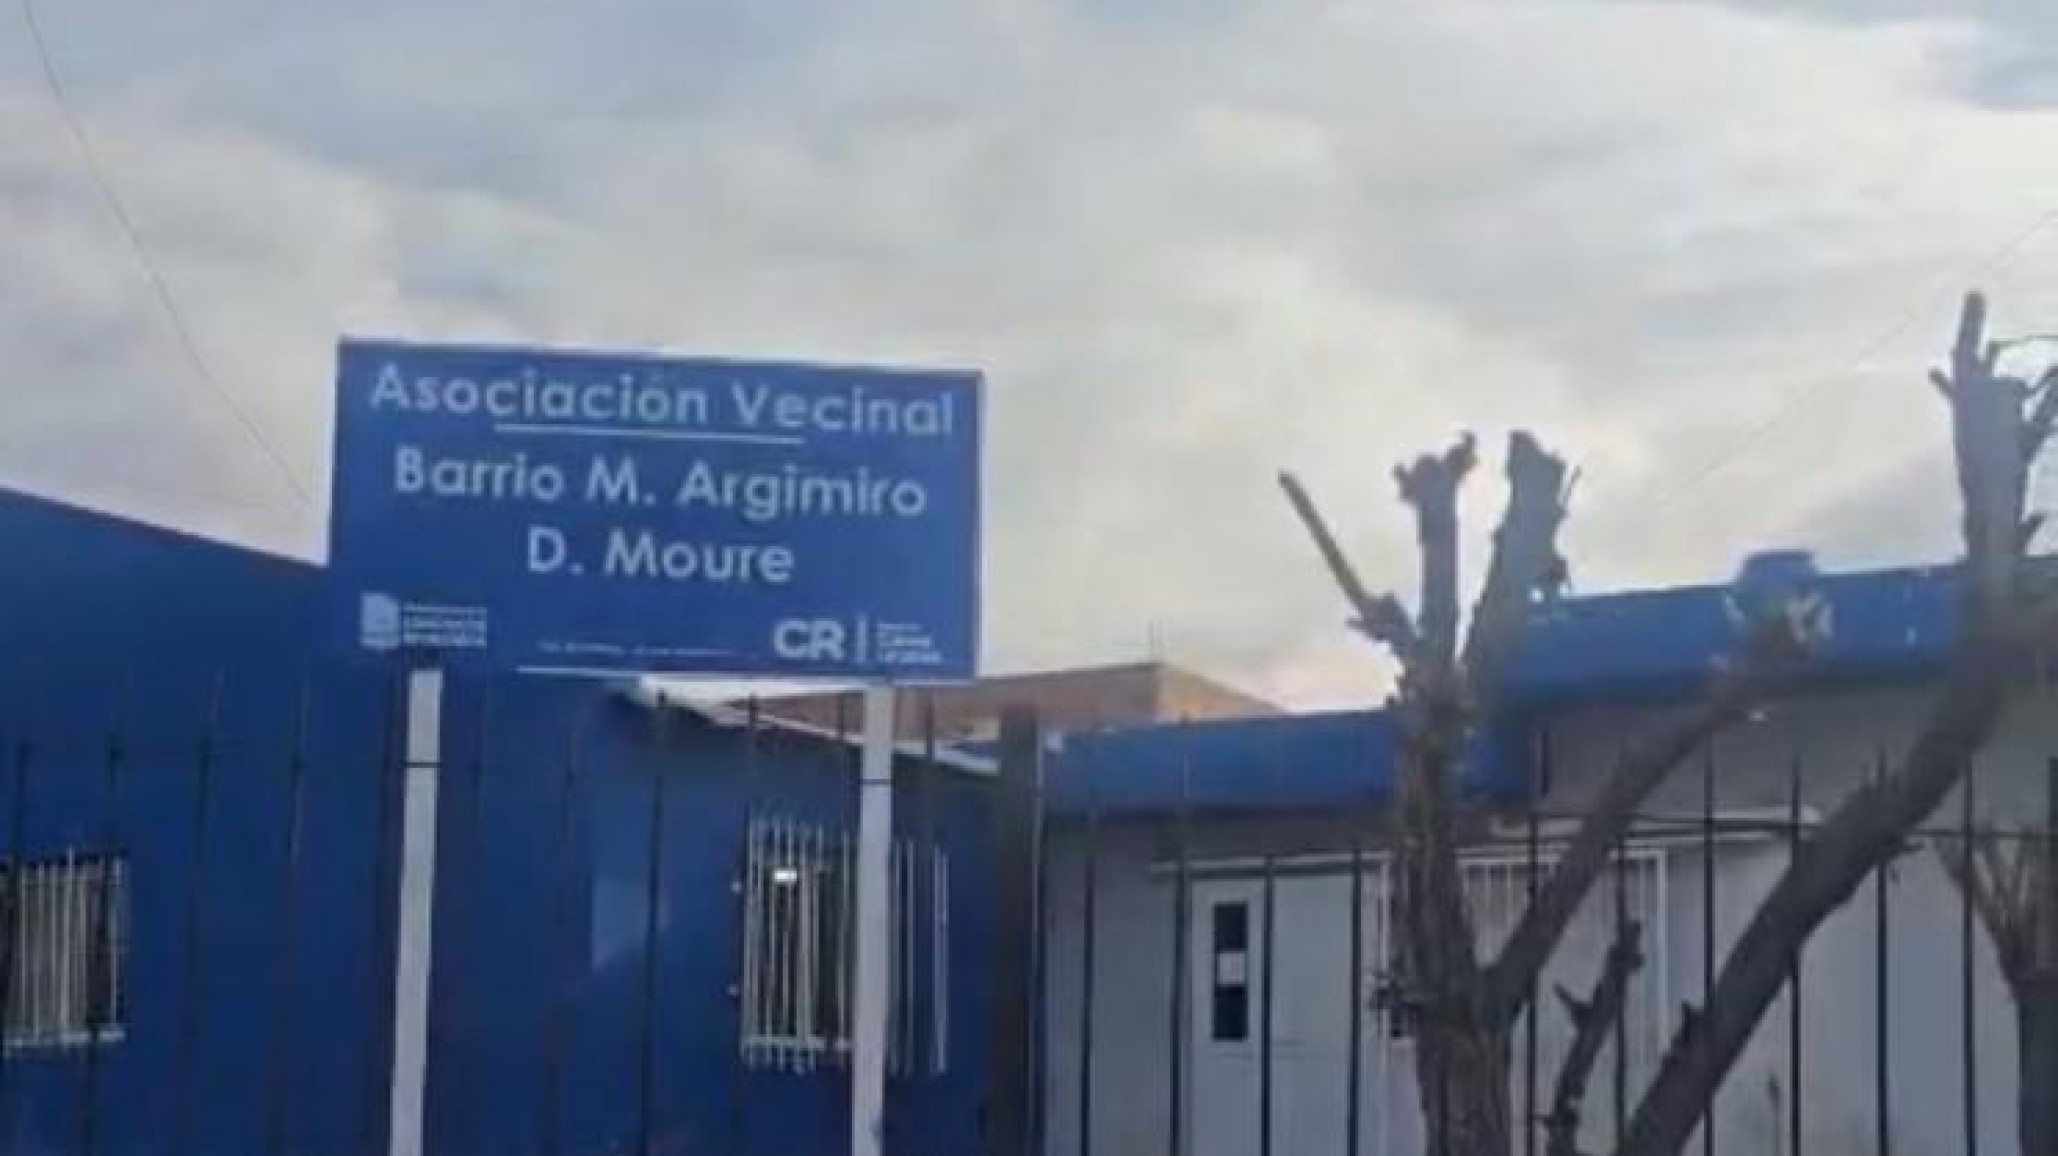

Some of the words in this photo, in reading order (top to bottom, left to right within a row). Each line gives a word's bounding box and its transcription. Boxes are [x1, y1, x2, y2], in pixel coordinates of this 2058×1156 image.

[370, 364, 708, 424] Asociación
[732, 382, 953, 435] Vecinal
[396, 446, 565, 500] Barrio
[587, 457, 657, 504] M.
[678, 462, 927, 520] Argimiro
[528, 527, 583, 575] D.
[604, 529, 795, 581] Moure
[774, 618, 845, 661] CR
